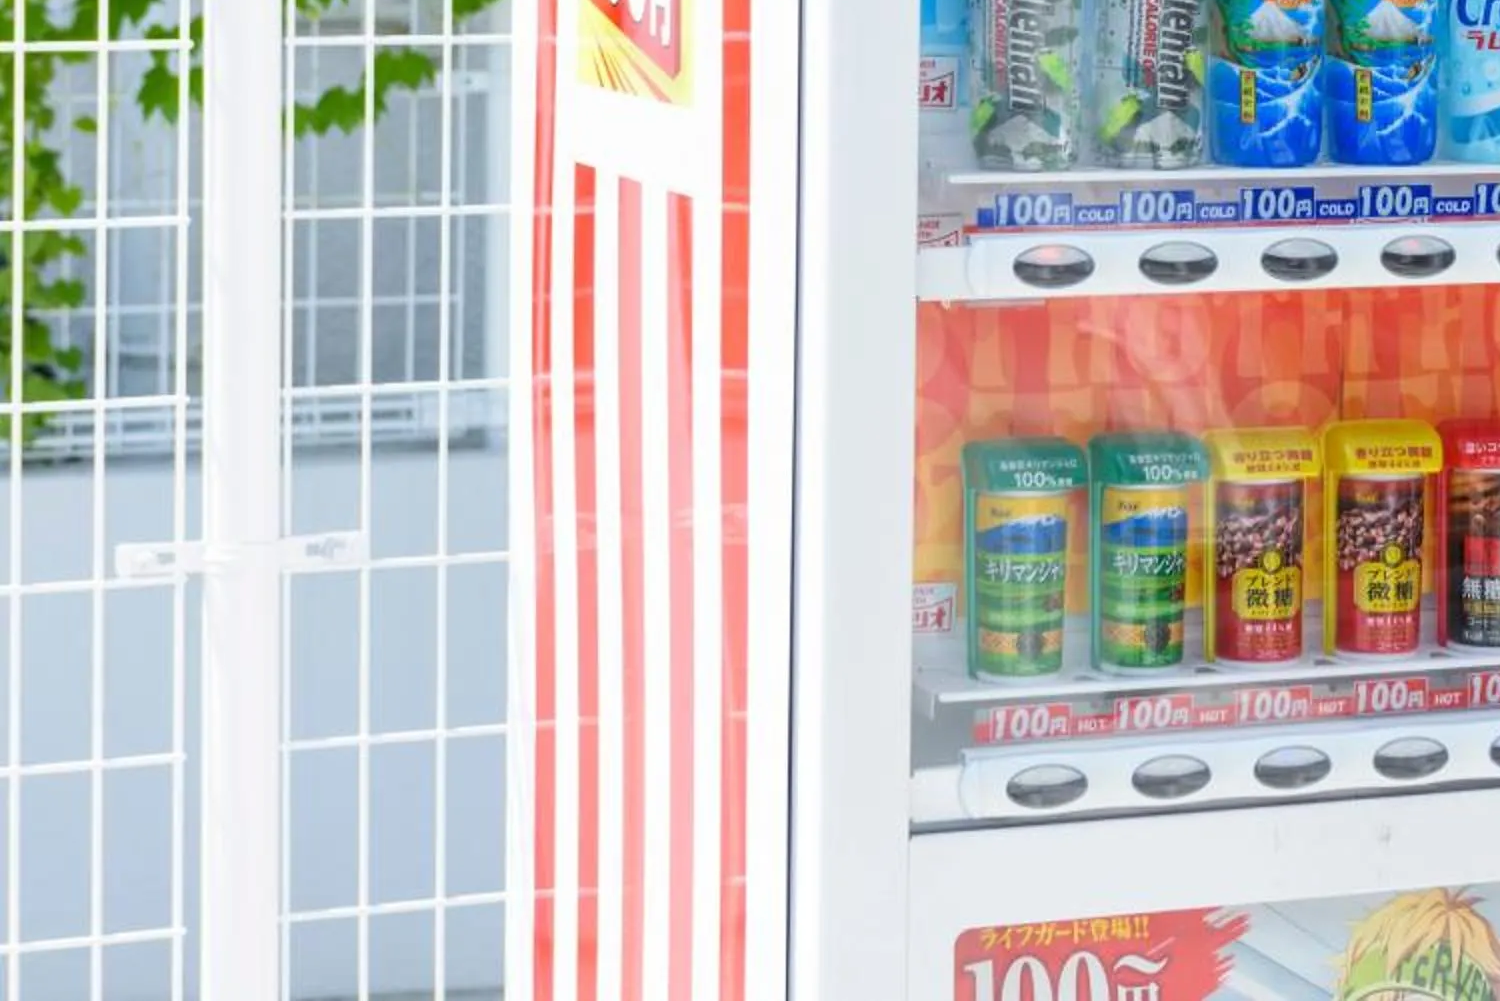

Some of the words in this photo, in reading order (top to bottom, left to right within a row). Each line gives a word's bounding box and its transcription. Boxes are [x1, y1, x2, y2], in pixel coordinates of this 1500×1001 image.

[997, 194, 1071, 226] 100円
[1121, 192, 1193, 223] 100円
[1199, 205, 1235, 219] COLD
[1242, 189, 1313, 219] 100円
[1319, 202, 1355, 216] COLD
[1360, 186, 1430, 216] 100円
[1436, 200, 1471, 214] COLD
[1077, 206, 1115, 222] COLD
[1238, 690, 1310, 720] 100円
[1318, 700, 1347, 714] HOT
[1356, 681, 1425, 712] 100円
[1433, 692, 1462, 705] HOT
[992, 708, 1068, 739] 100円
[1077, 718, 1108, 732] HOT
[1116, 699, 1189, 730] 100円
[1199, 708, 1228, 723] HOT
